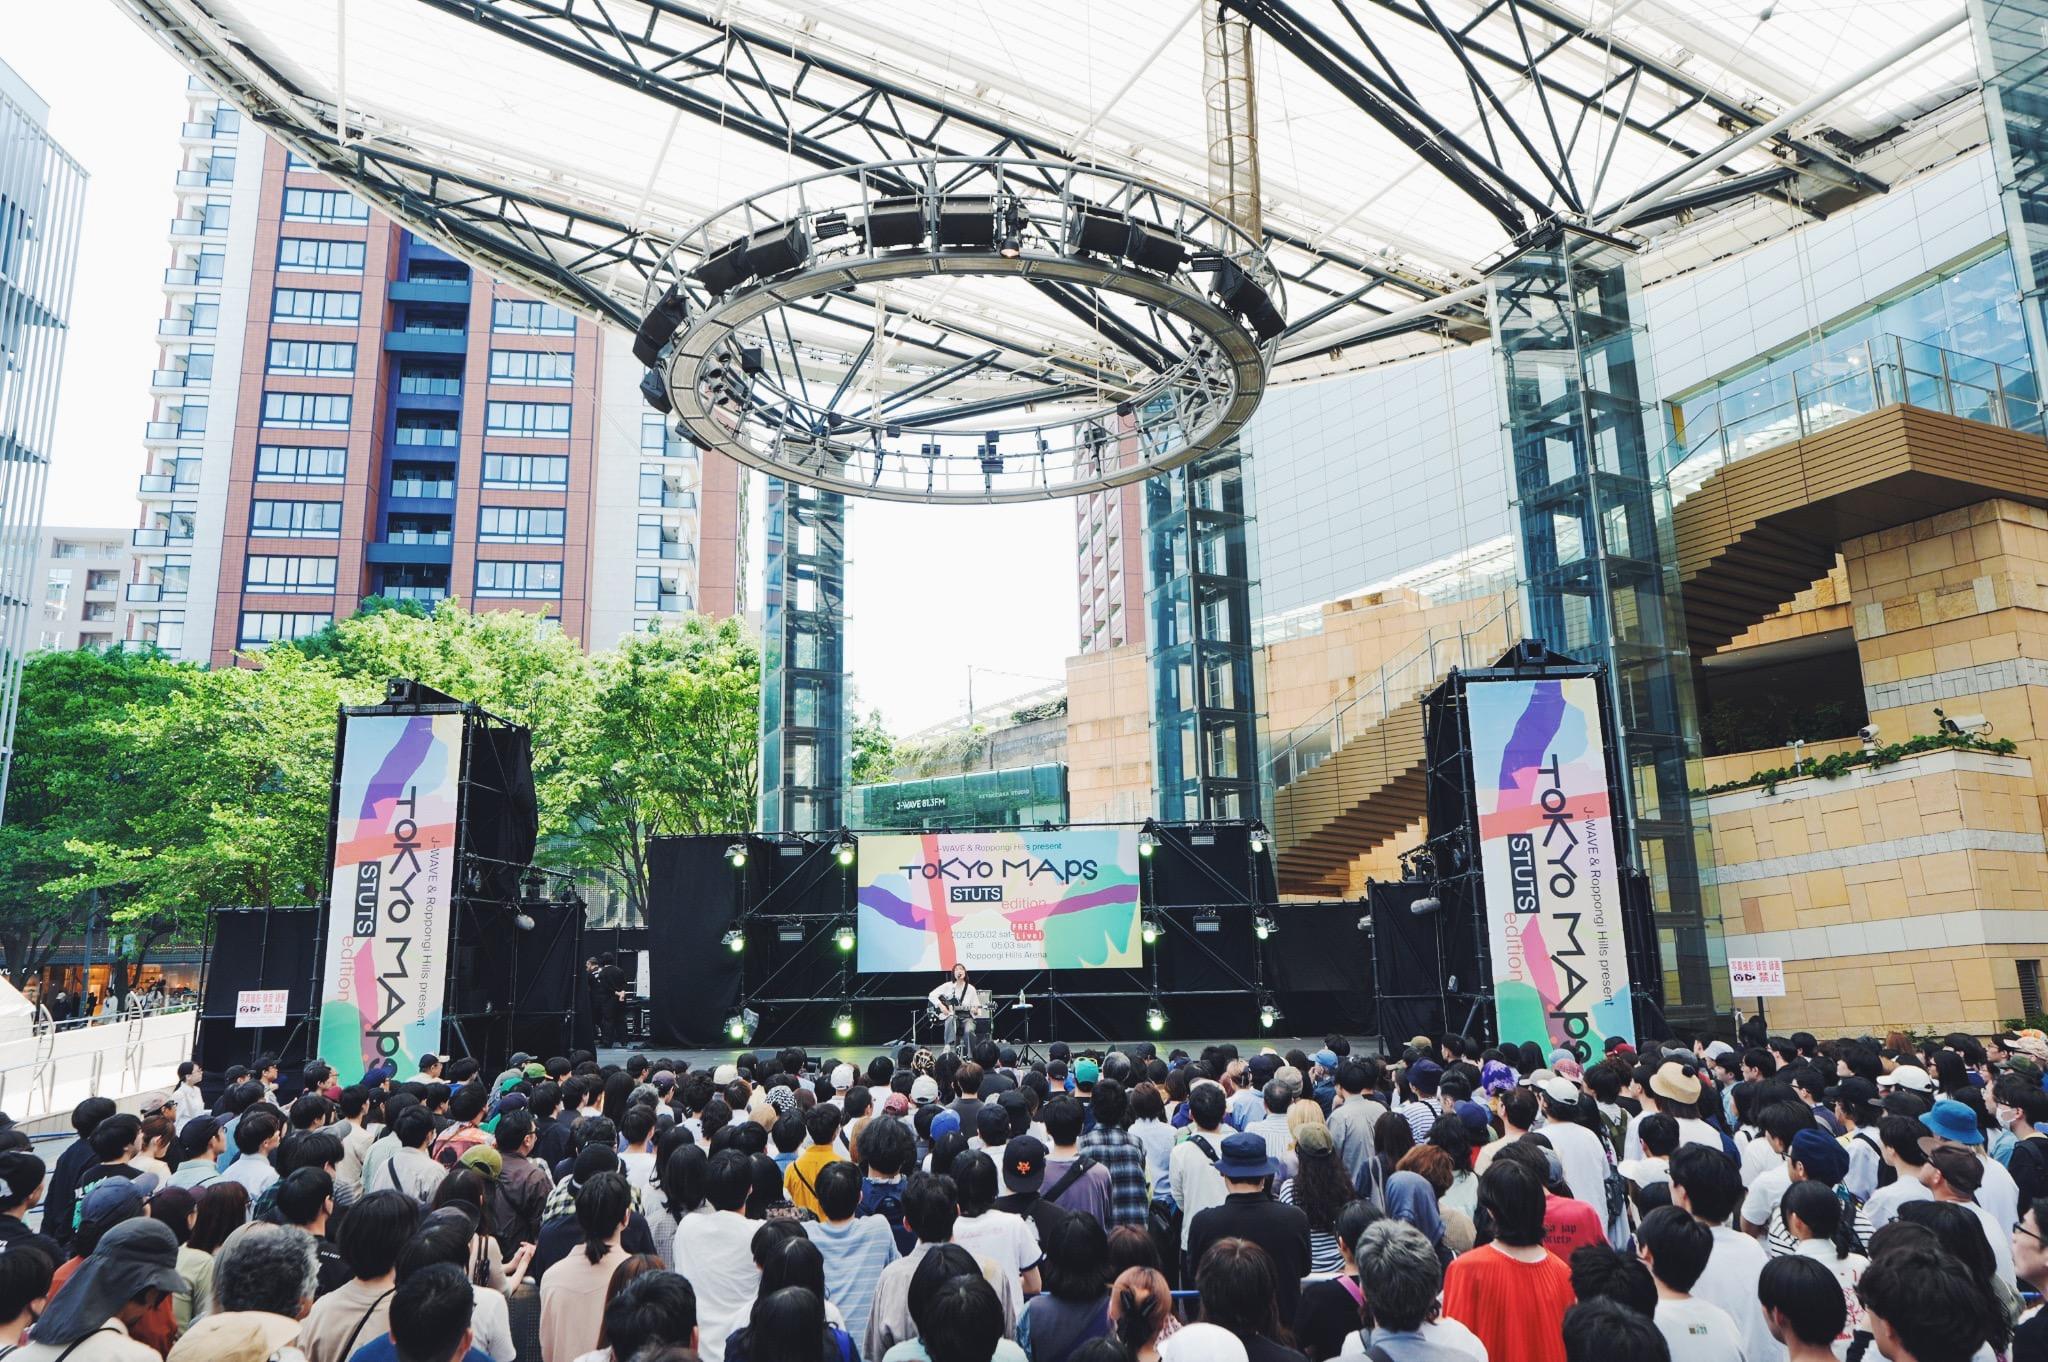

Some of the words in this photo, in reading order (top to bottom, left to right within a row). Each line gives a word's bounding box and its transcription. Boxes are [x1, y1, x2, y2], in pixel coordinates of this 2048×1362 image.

[896, 799, 921, 811] J-WAVE
[921, 797, 946, 808] 81.3FM
[1538, 754, 1579, 898] TOKYO
[1583, 806, 1599, 854] J-WAVE
[387, 786, 422, 923] TOKYO
[428, 837, 440, 882] J-WAVE
[935, 844, 966, 853] J-WAVE
[966, 843, 973, 852] &
[974, 842, 1012, 854] Roppongi
[1032, 842, 1062, 852] present
[899, 857, 993, 881] TOKYO
[1589, 857, 1600, 866] &
[1511, 838, 1537, 911] STUTS
[356, 864, 378, 934] STUTS
[427, 885, 437, 894] &
[952, 887, 1001, 901] STUTS
[1590, 870, 1604, 927] Roppongi
[1001, 897, 1046, 910] edition
[421, 897, 436, 952] Roppongi
[1012, 923, 1034, 931] FREE
[966, 941, 974, 949] at
[966, 952, 1003, 961] Roppongi
[1024, 951, 1048, 959] Arena
[991, 941, 1015, 949] 05.03
[1016, 941, 1032, 949] sun
[1504, 912, 1524, 982] edition
[1597, 931, 1609, 957] Hills
[338, 935, 354, 1002] edition
[420, 955, 432, 979] Hills
[1759, 971, 1781, 983] 禁止
[1598, 960, 1614, 1007] present
[263, 1004, 284, 1014] 禁止
[416, 982, 429, 1027] present
